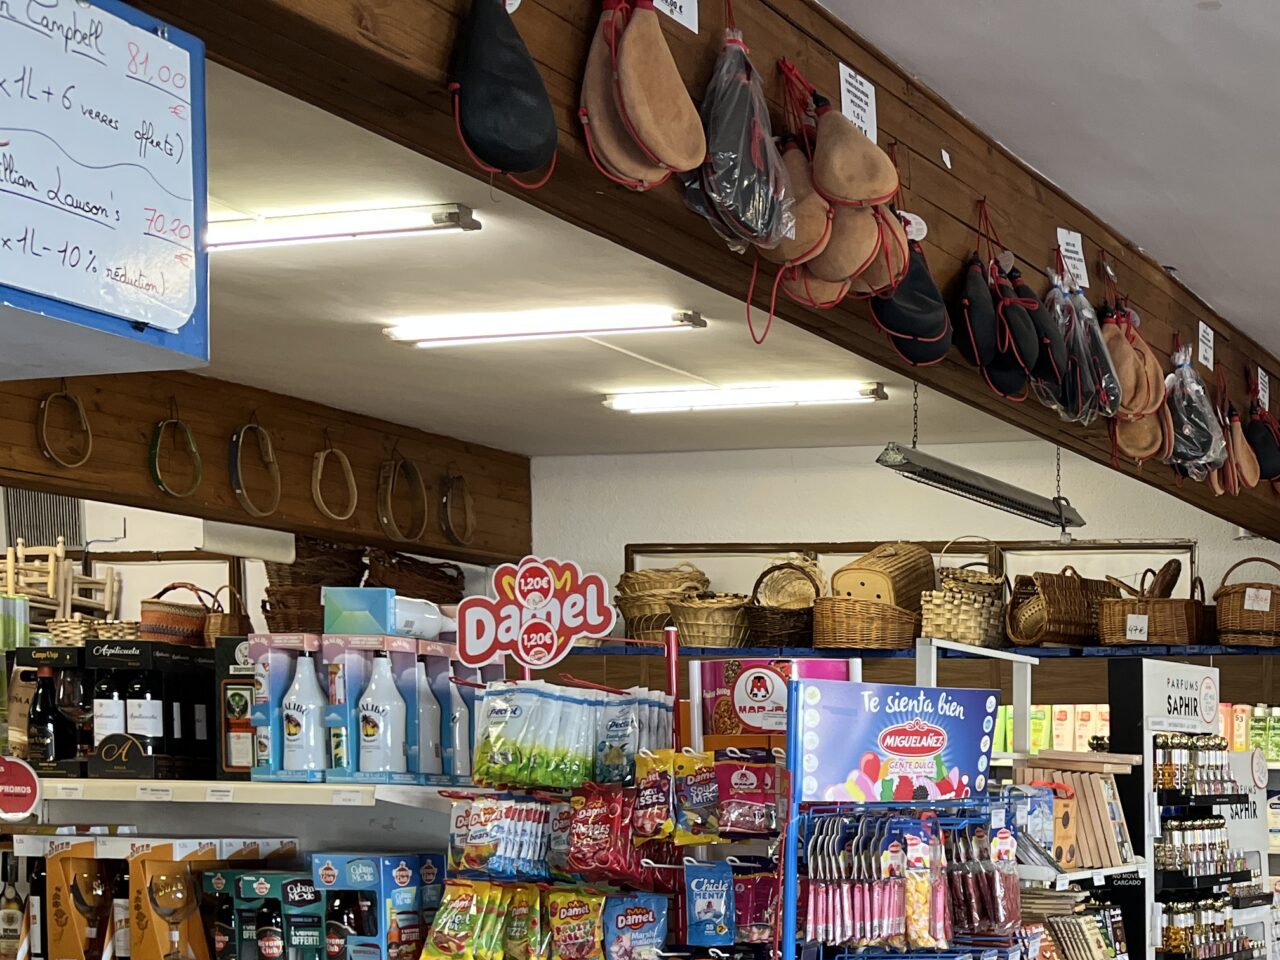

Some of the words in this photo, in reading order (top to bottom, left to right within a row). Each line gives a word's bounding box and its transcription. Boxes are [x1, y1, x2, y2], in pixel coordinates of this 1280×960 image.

[520, 577, 549, 592] 1,20€
[465, 584, 604, 656] Damel
[523, 632, 552, 647] 1,20€
[1167, 677, 1199, 692] PARFUMS
[861, 691, 880, 713] Te
[885, 690, 934, 714] sienta
[938, 692, 965, 720] bien
[1167, 694, 1199, 717] SAPHIR
[883, 732, 945, 748] MIGUELAÑEZ
[889, 761, 912, 769] GENTE
[914, 760, 935, 769] DULCE
[1230, 800, 1258, 820] SAPHIR
[350, 863, 374, 876] Cuban
[287, 884, 315, 894] Cuban
[691, 878, 729, 893] Chicle
[288, 891, 315, 902] Mode
[694, 891, 726, 899] MENTA
[560, 905, 590, 919] Damel
[618, 910, 654, 928] Damel
[291, 936, 320, 946] OFFERT!
